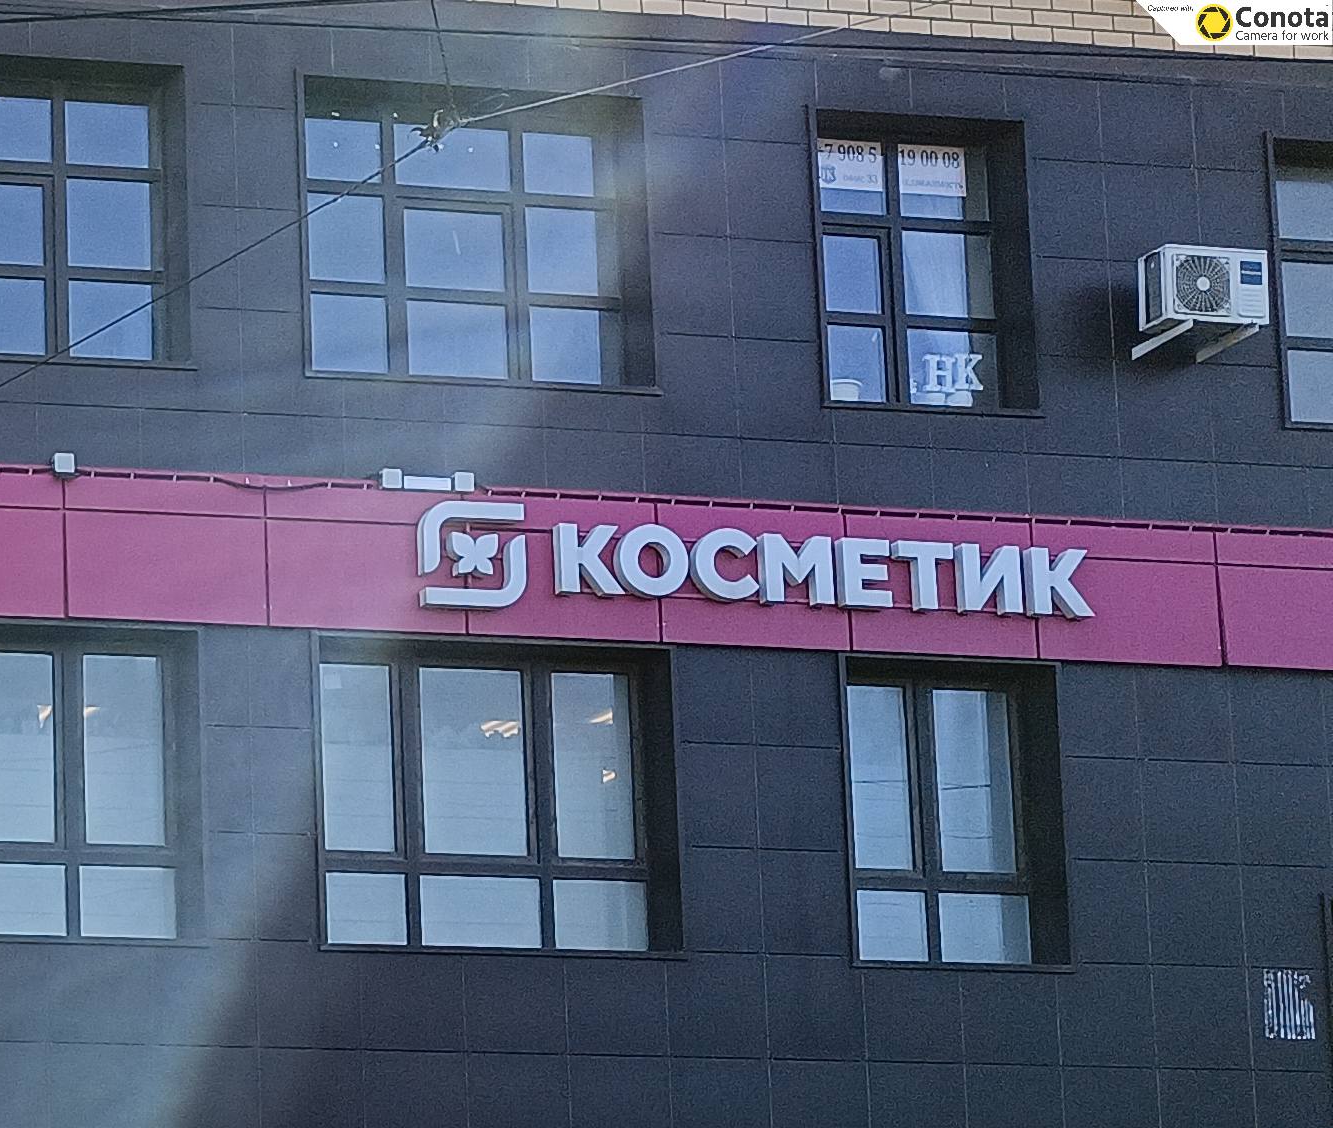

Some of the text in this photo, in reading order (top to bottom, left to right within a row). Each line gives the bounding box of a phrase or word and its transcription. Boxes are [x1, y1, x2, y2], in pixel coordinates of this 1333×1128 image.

[837, 144, 864, 163] 908
[868, 146, 878, 164] 5
[899, 148, 916, 166] 19
[920, 150, 938, 168] 00
[942, 151, 960, 169] 08
[552, 521, 1095, 619] КОСМЕТИК
